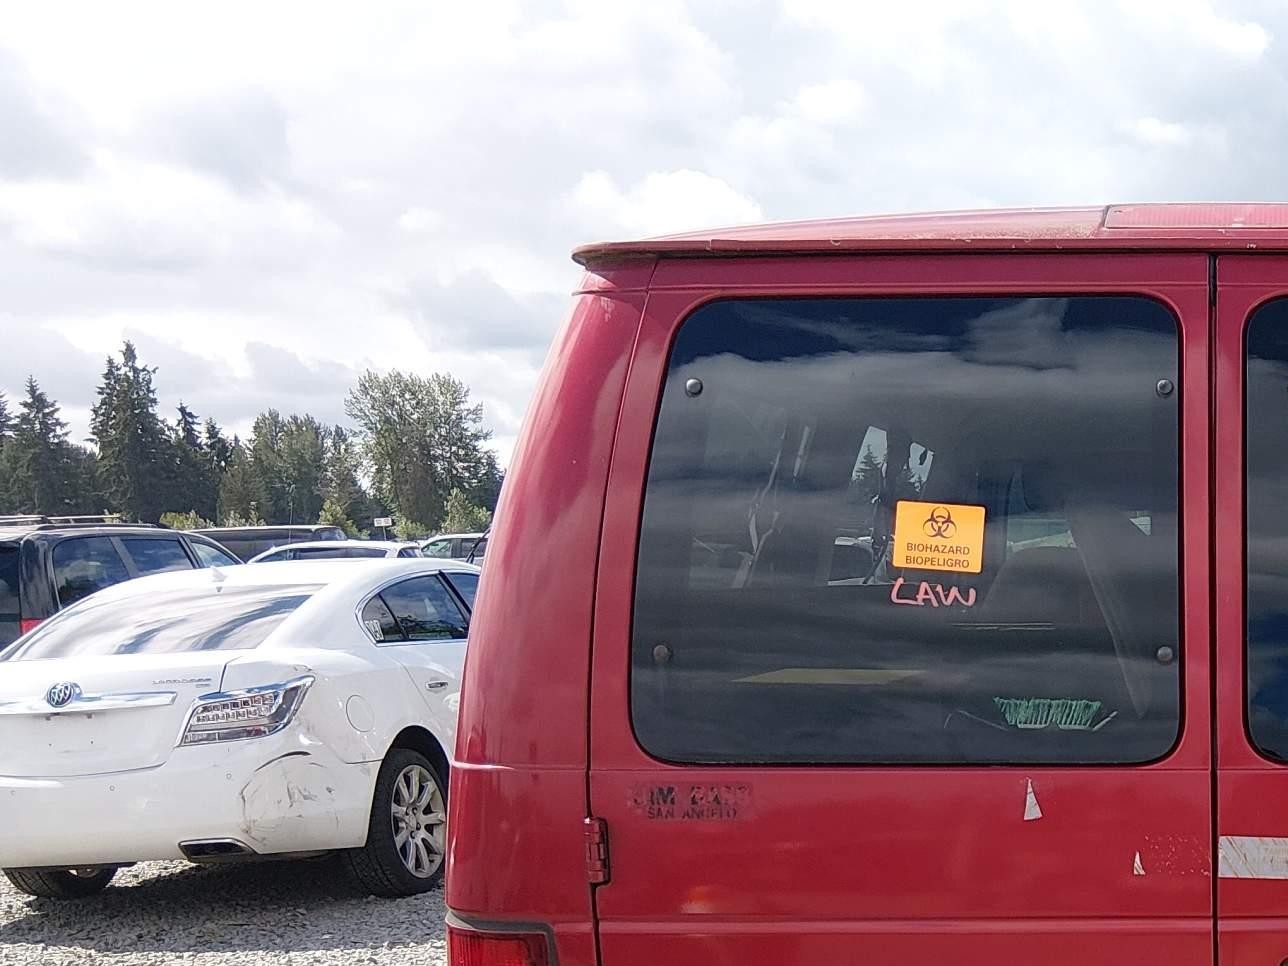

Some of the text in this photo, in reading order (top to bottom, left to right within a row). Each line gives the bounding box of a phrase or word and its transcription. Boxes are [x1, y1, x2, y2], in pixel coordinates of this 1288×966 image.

[906, 542, 970, 555] BIOHAZARD
[905, 555, 970, 568] BIOPELIGRO
[890, 577, 977, 607] LAW
